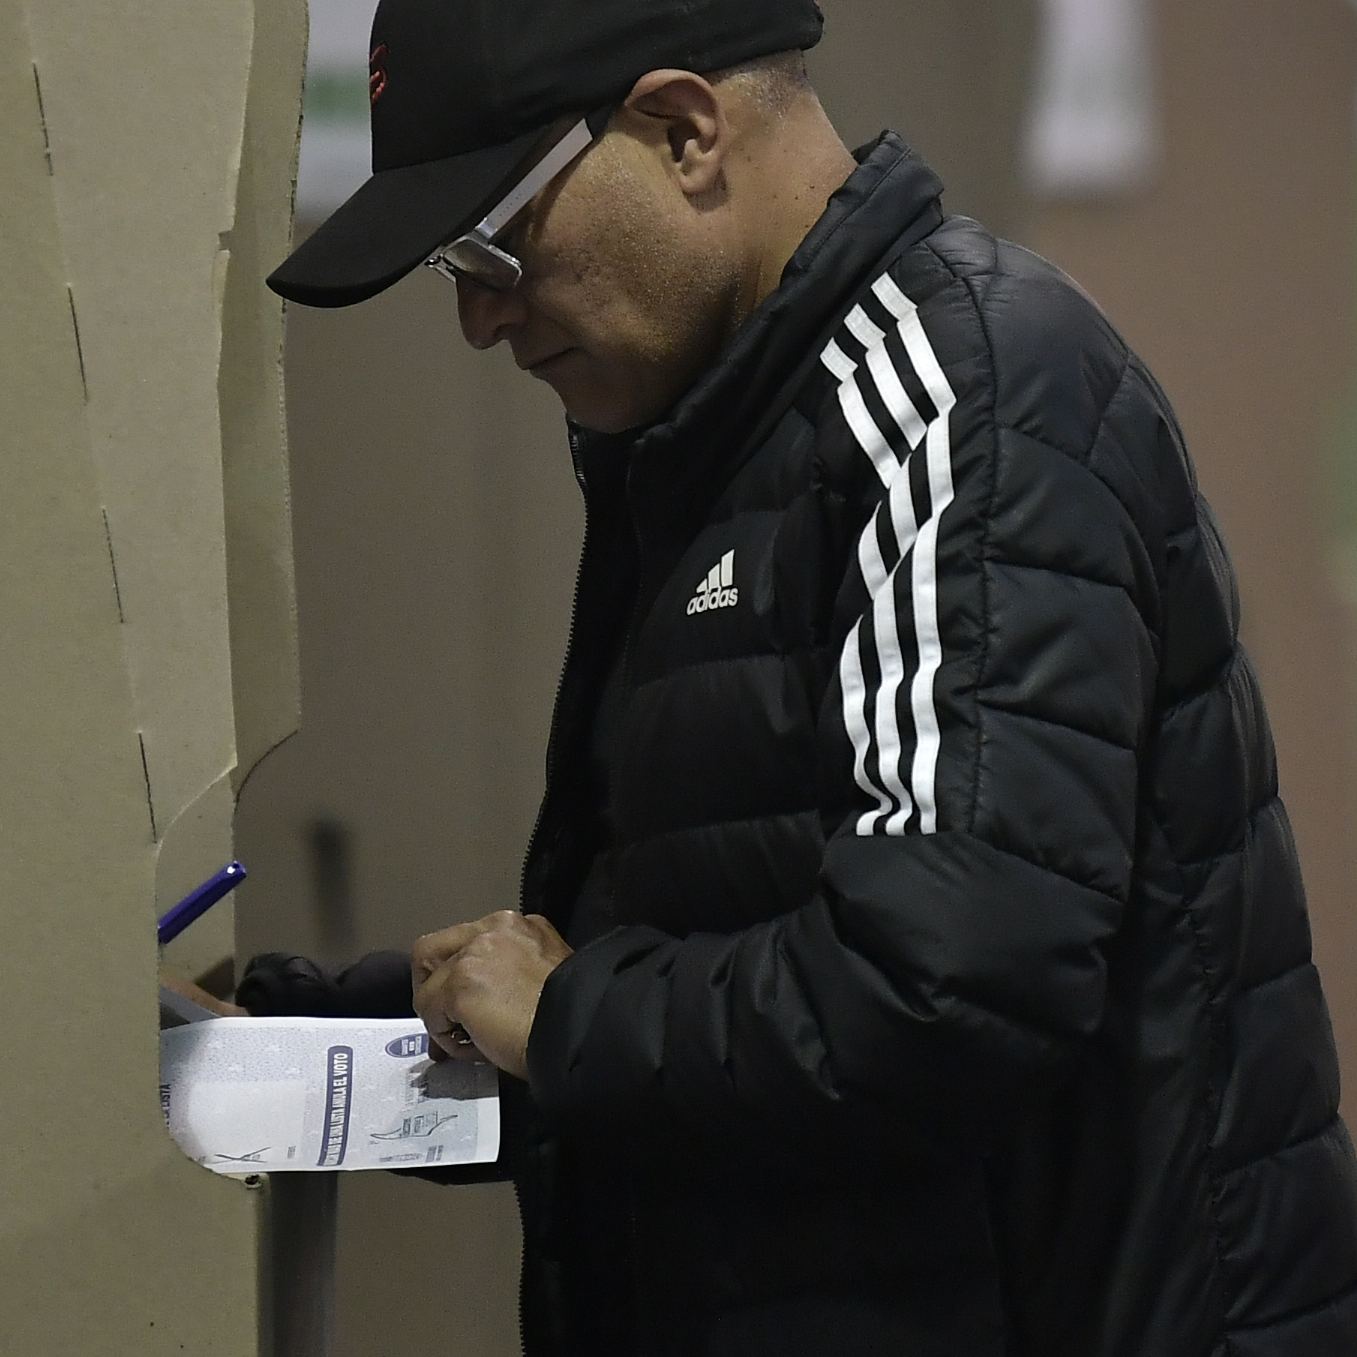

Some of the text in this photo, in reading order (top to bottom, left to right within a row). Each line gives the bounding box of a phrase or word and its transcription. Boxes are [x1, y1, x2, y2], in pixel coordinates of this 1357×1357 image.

[686, 586, 739, 616] adidas
[333, 1053, 348, 1076] VOTO
[333, 1077, 347, 1086] EL
